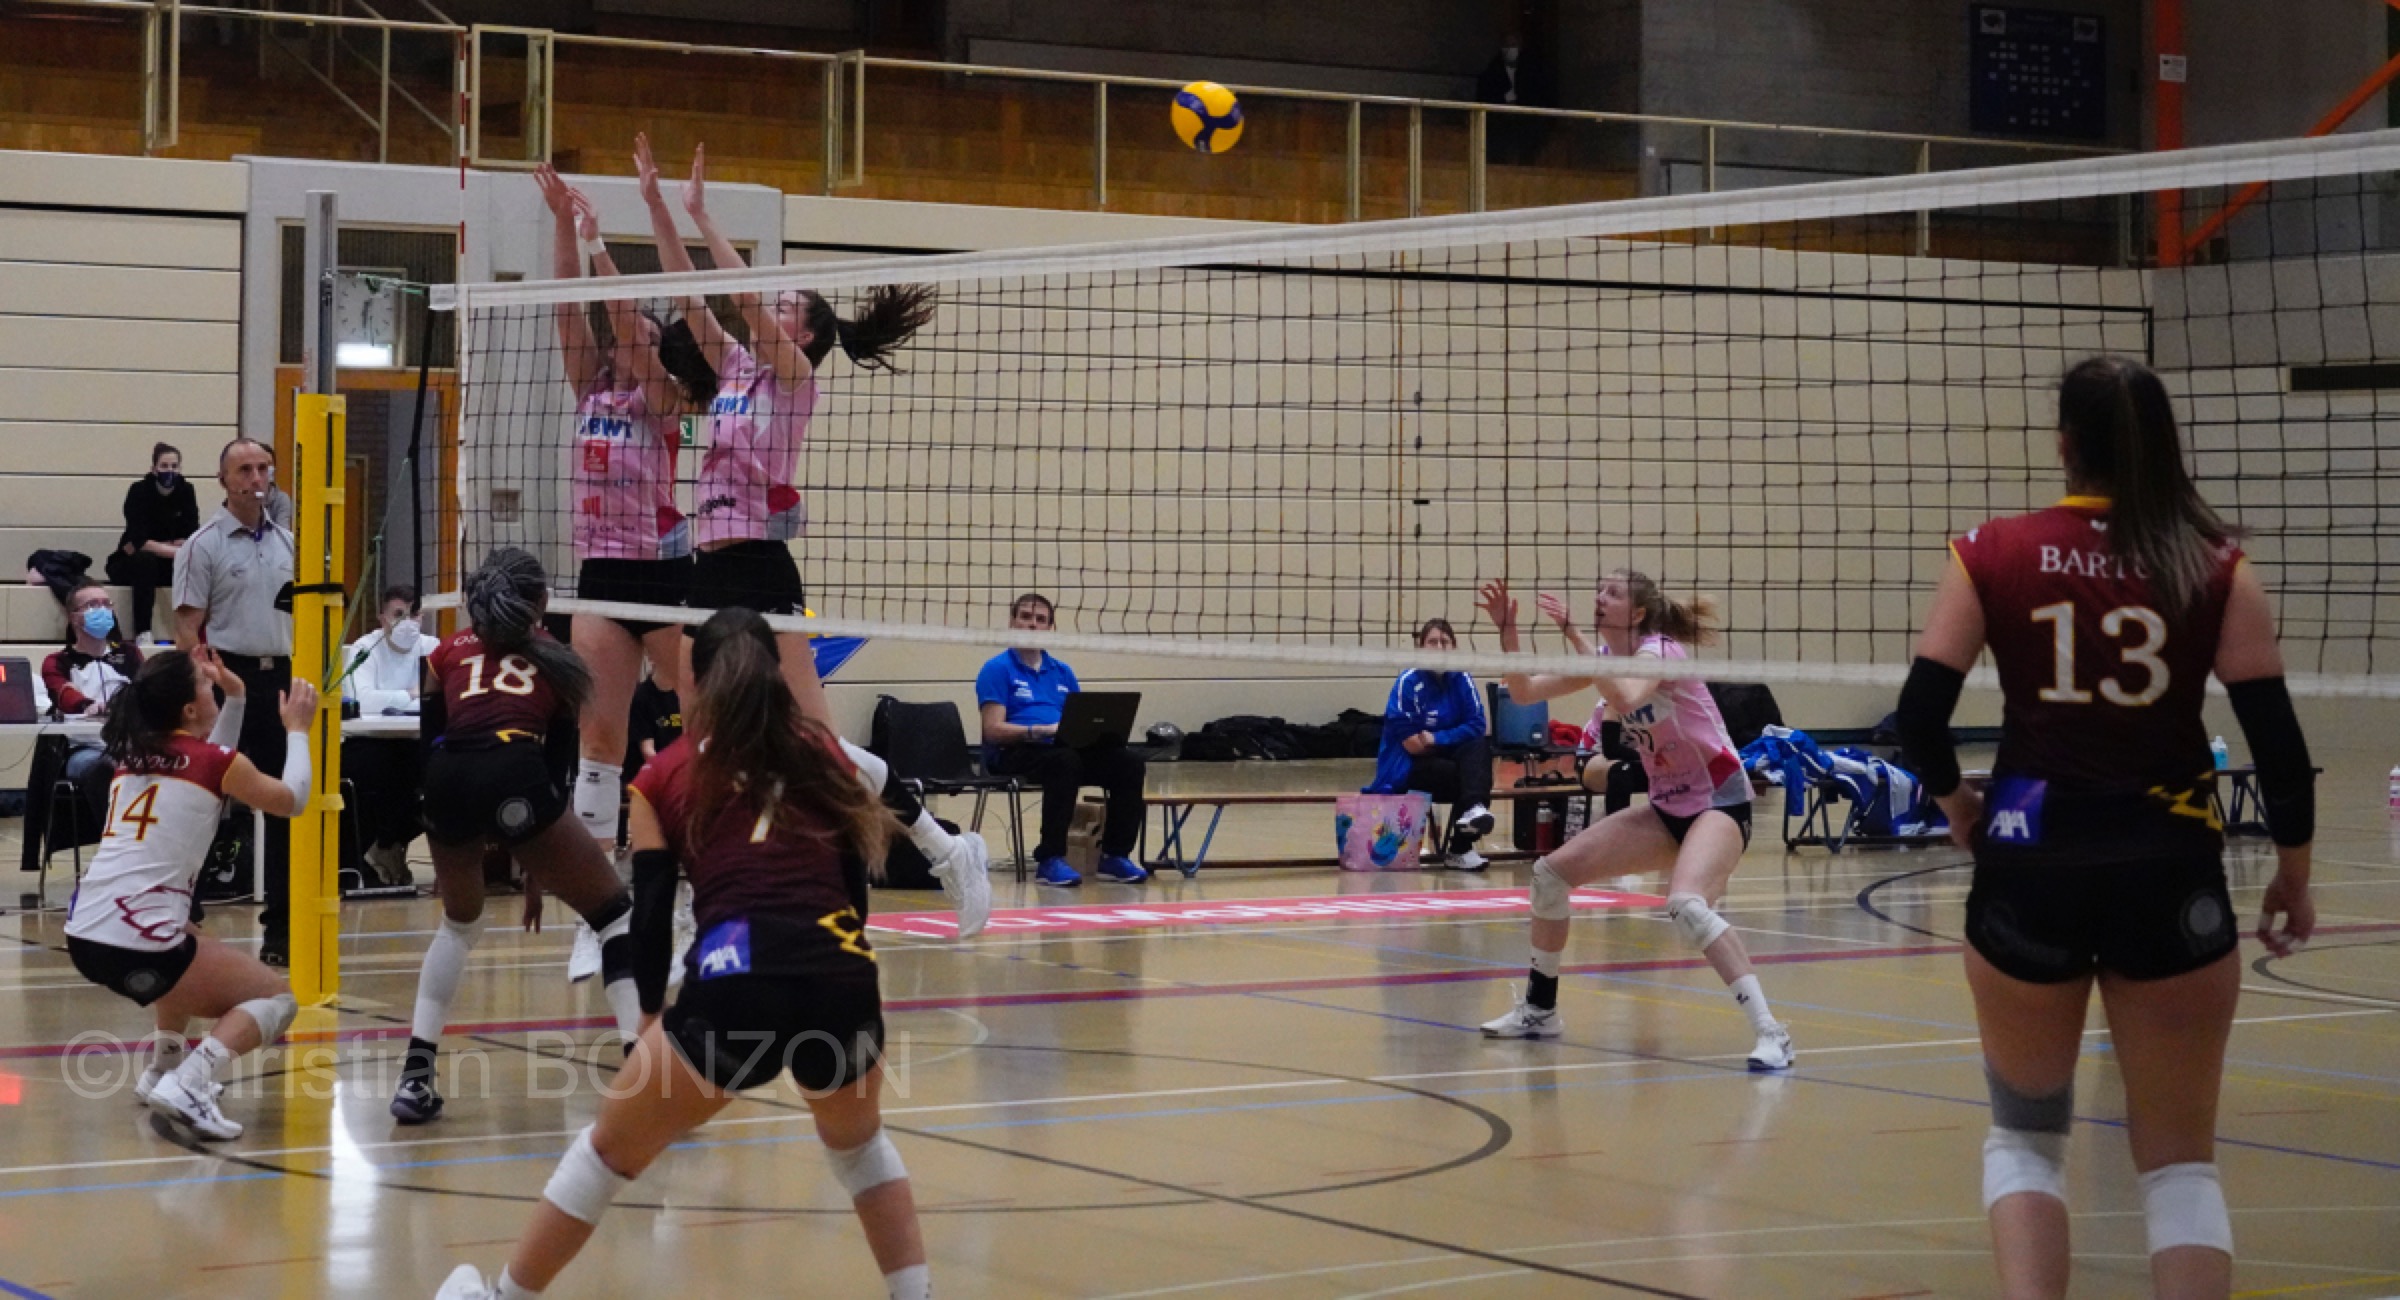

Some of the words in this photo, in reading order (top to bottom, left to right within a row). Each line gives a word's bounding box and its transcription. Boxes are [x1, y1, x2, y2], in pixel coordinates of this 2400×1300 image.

[460, 654, 538, 700] 18
[2031, 602, 2170, 706] 13
[102, 783, 160, 841] 14
[1988, 810, 2030, 838] AXA
